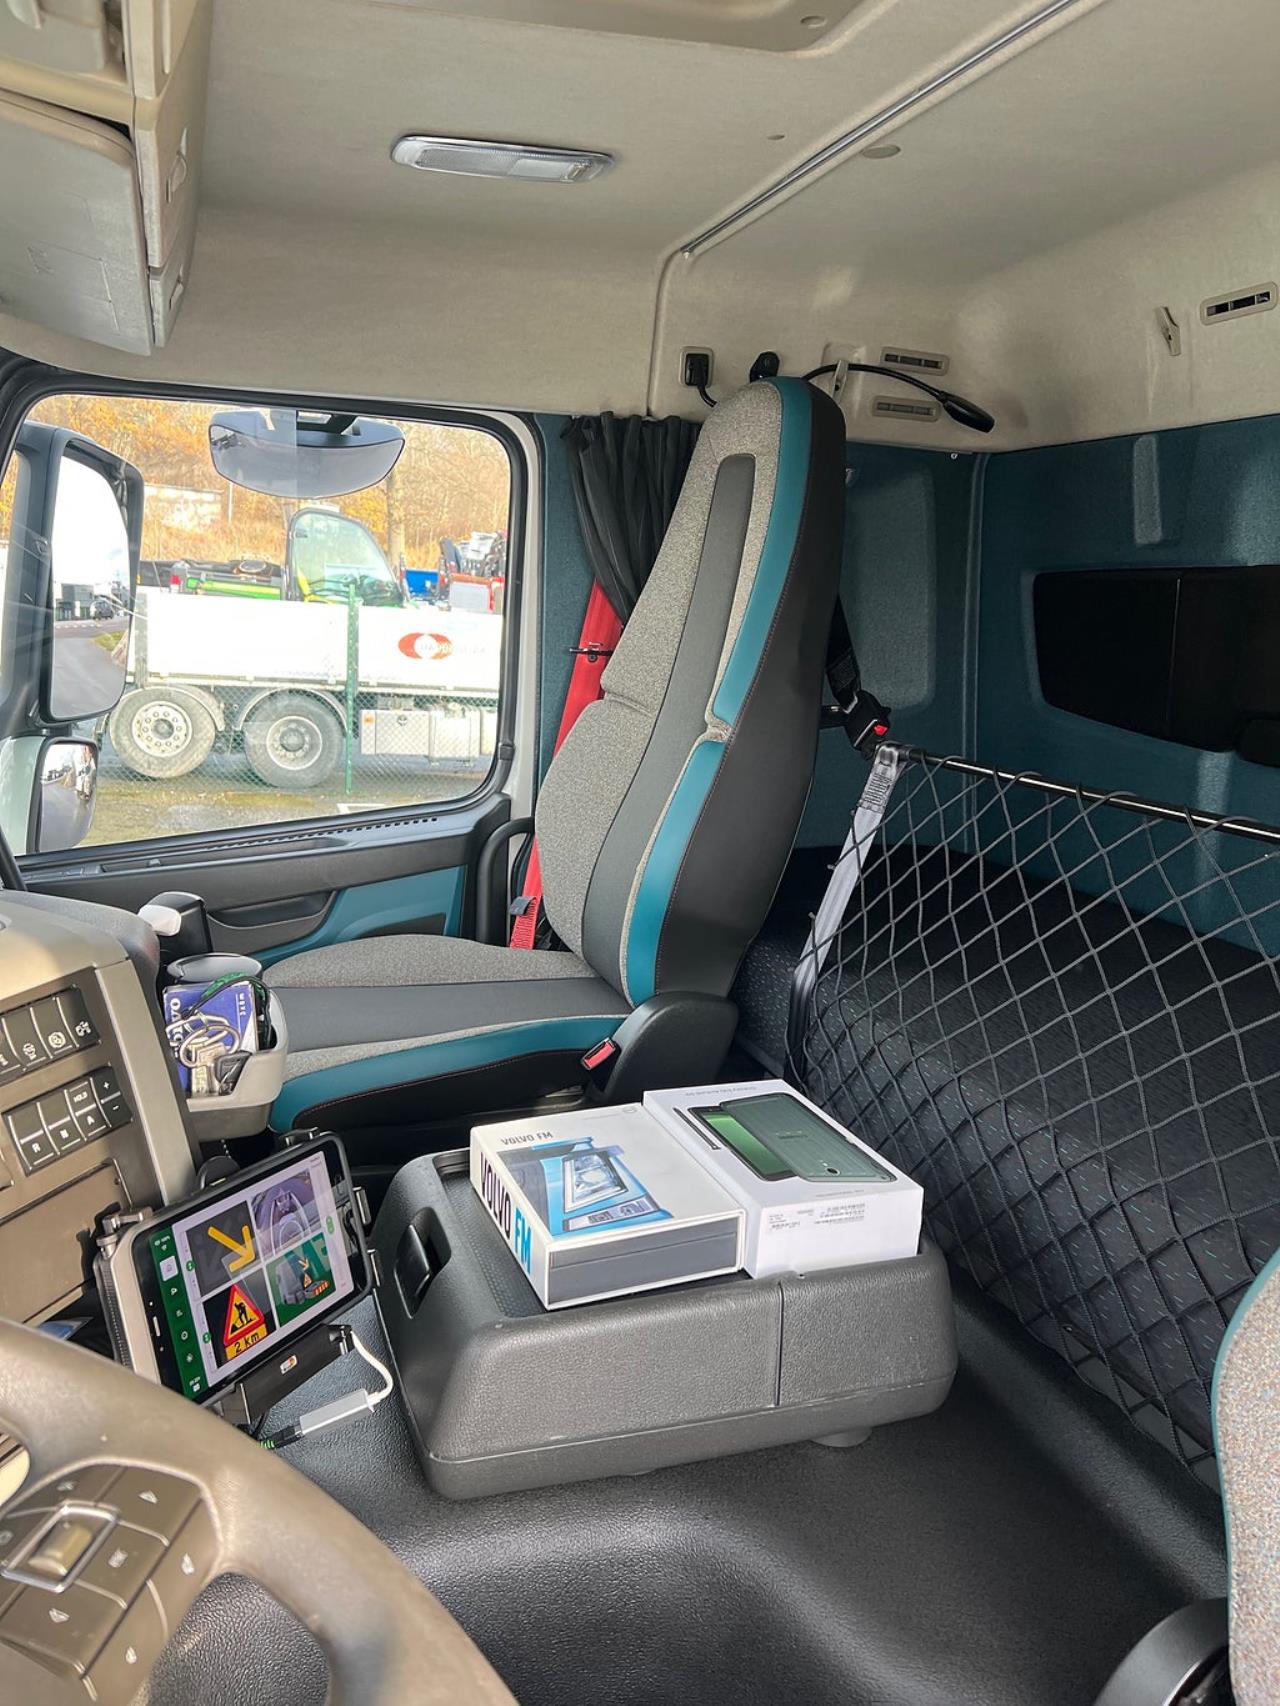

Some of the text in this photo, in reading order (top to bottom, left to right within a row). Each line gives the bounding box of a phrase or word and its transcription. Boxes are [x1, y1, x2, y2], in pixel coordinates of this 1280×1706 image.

[87, 1116, 95, 1126] A
[501, 1131, 554, 1146] VOLVO FM
[32, 1143, 41, 1153] R
[480, 1152, 532, 1275] VOLVO FM
[234, 1332, 260, 1354] 2 km
